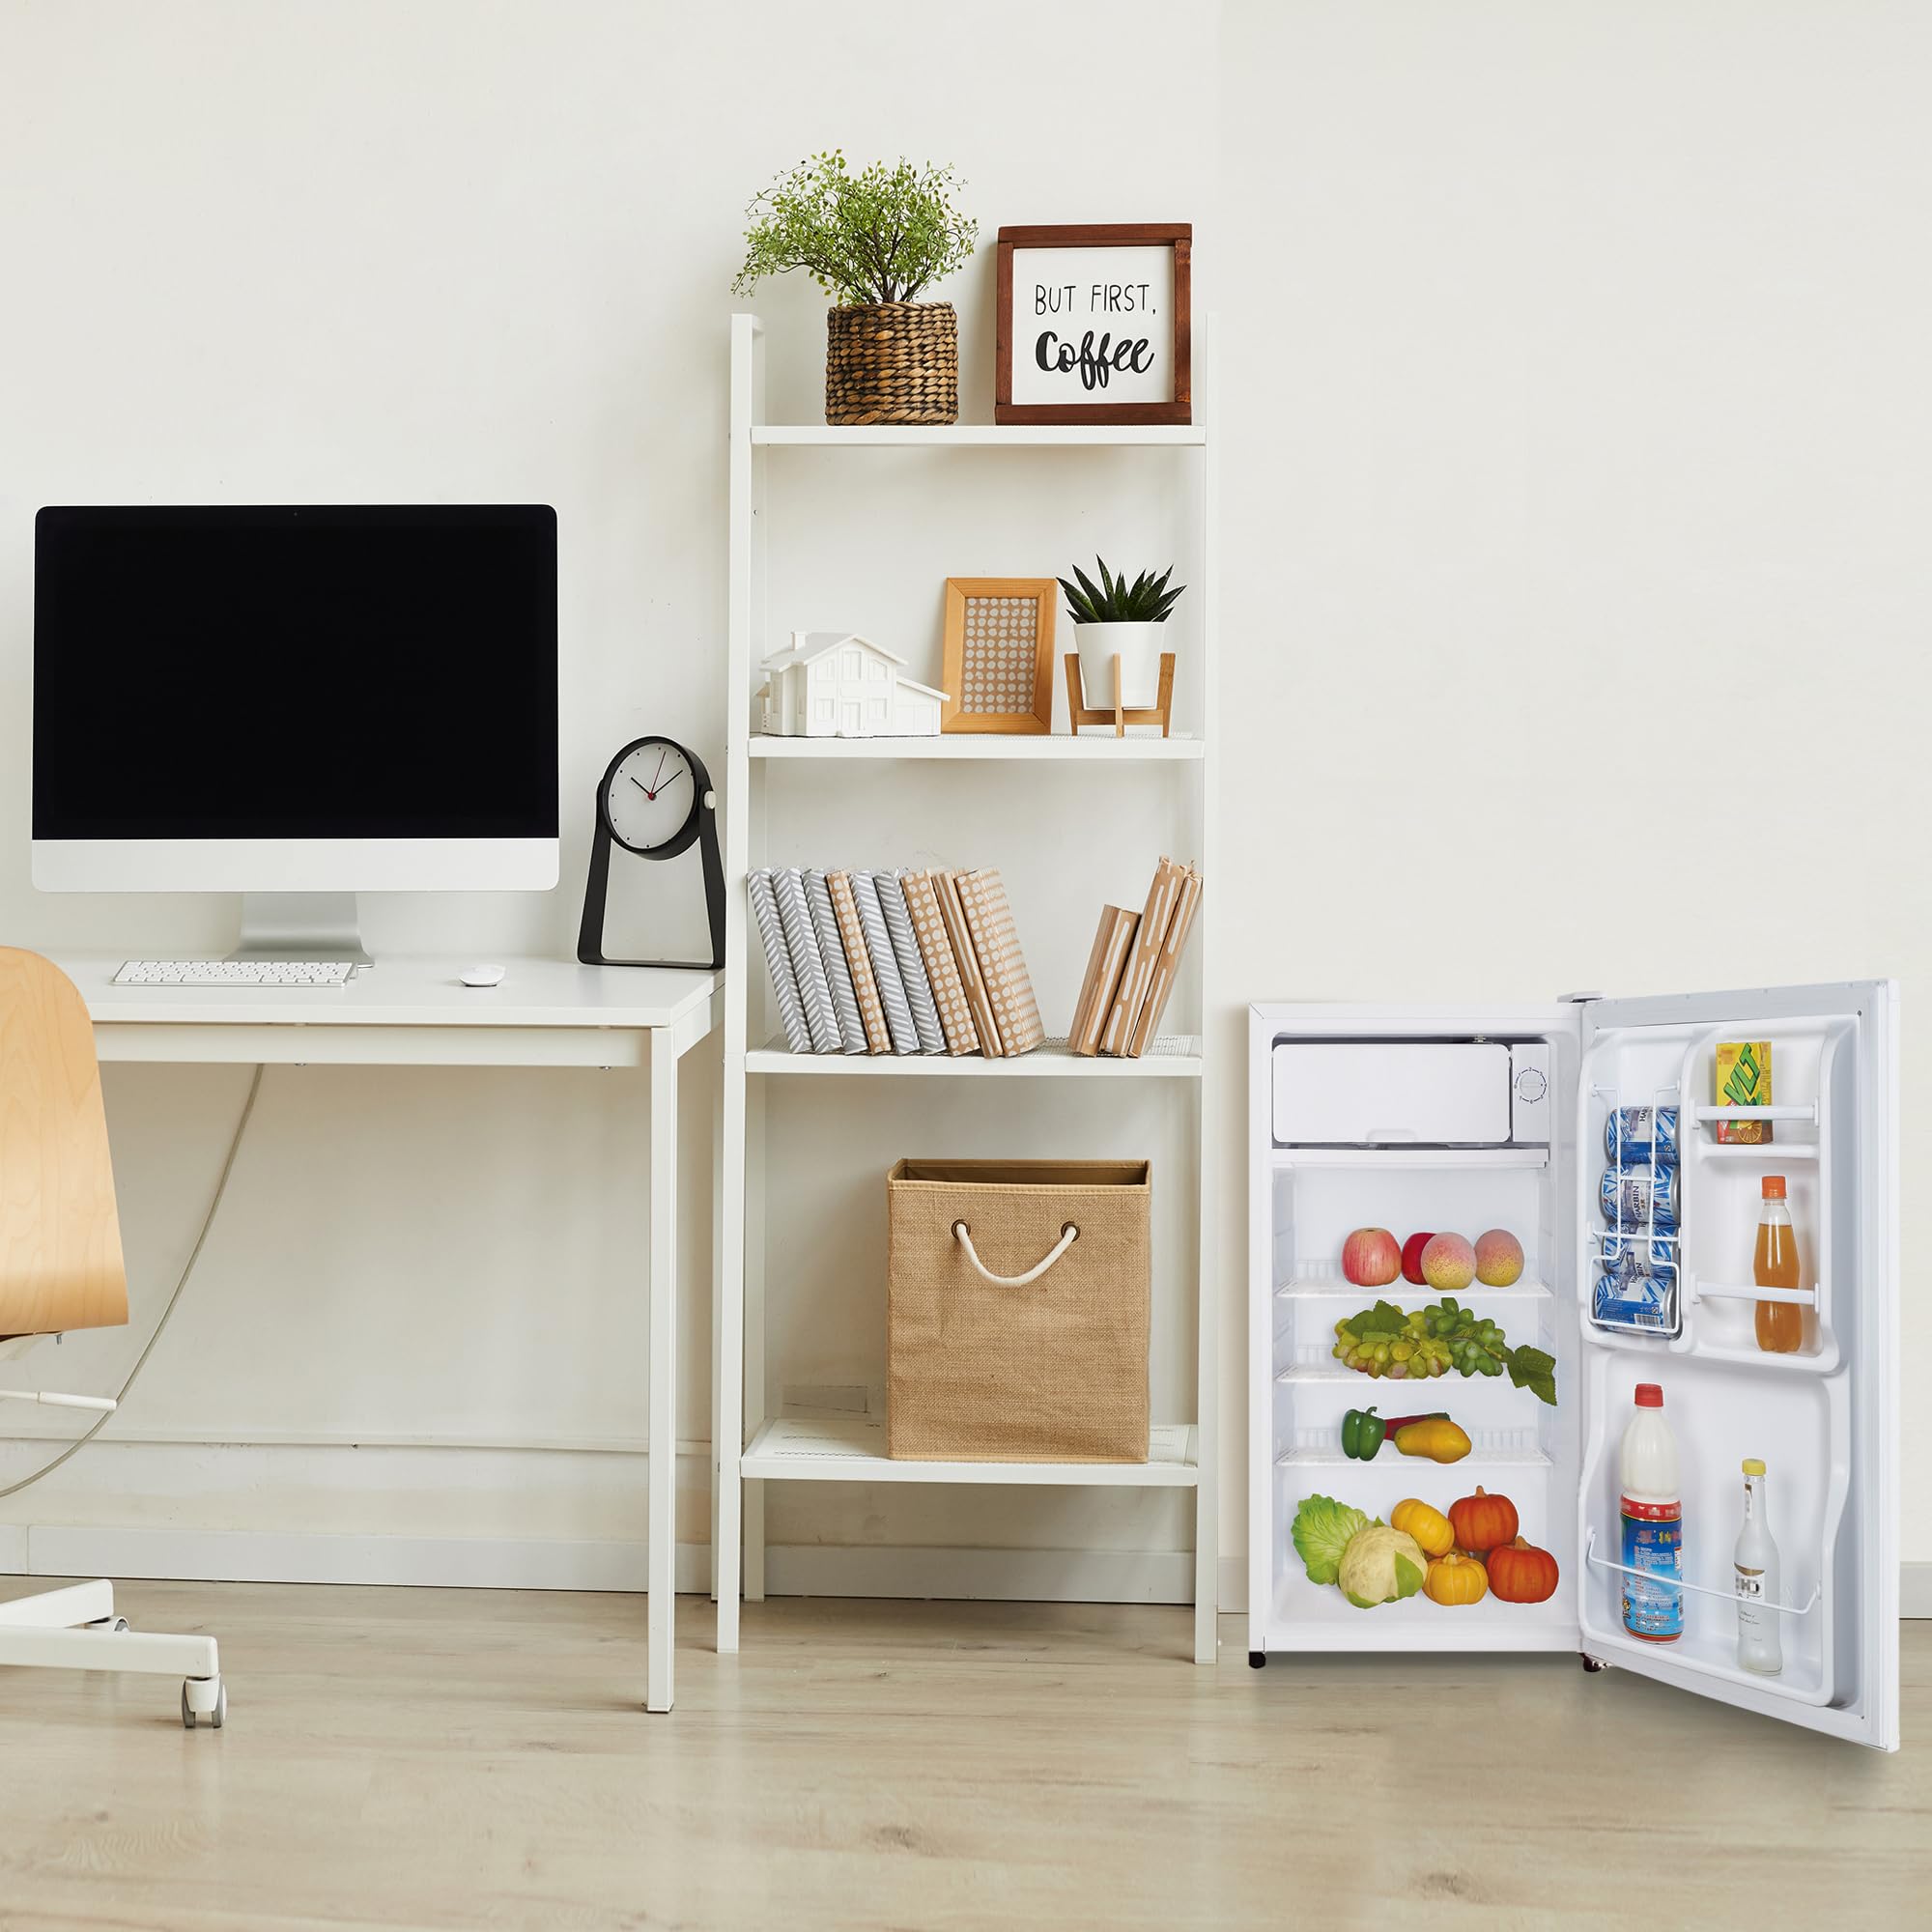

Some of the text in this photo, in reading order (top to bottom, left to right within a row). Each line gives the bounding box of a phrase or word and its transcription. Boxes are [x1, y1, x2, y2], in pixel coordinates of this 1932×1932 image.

[1035, 284, 1156, 316] BUT FIRST,
[1035, 330, 1155, 391] Coffee
[1722, 1043, 1760, 1106] VLT
[1633, 1185, 1643, 1218] HARBIN
